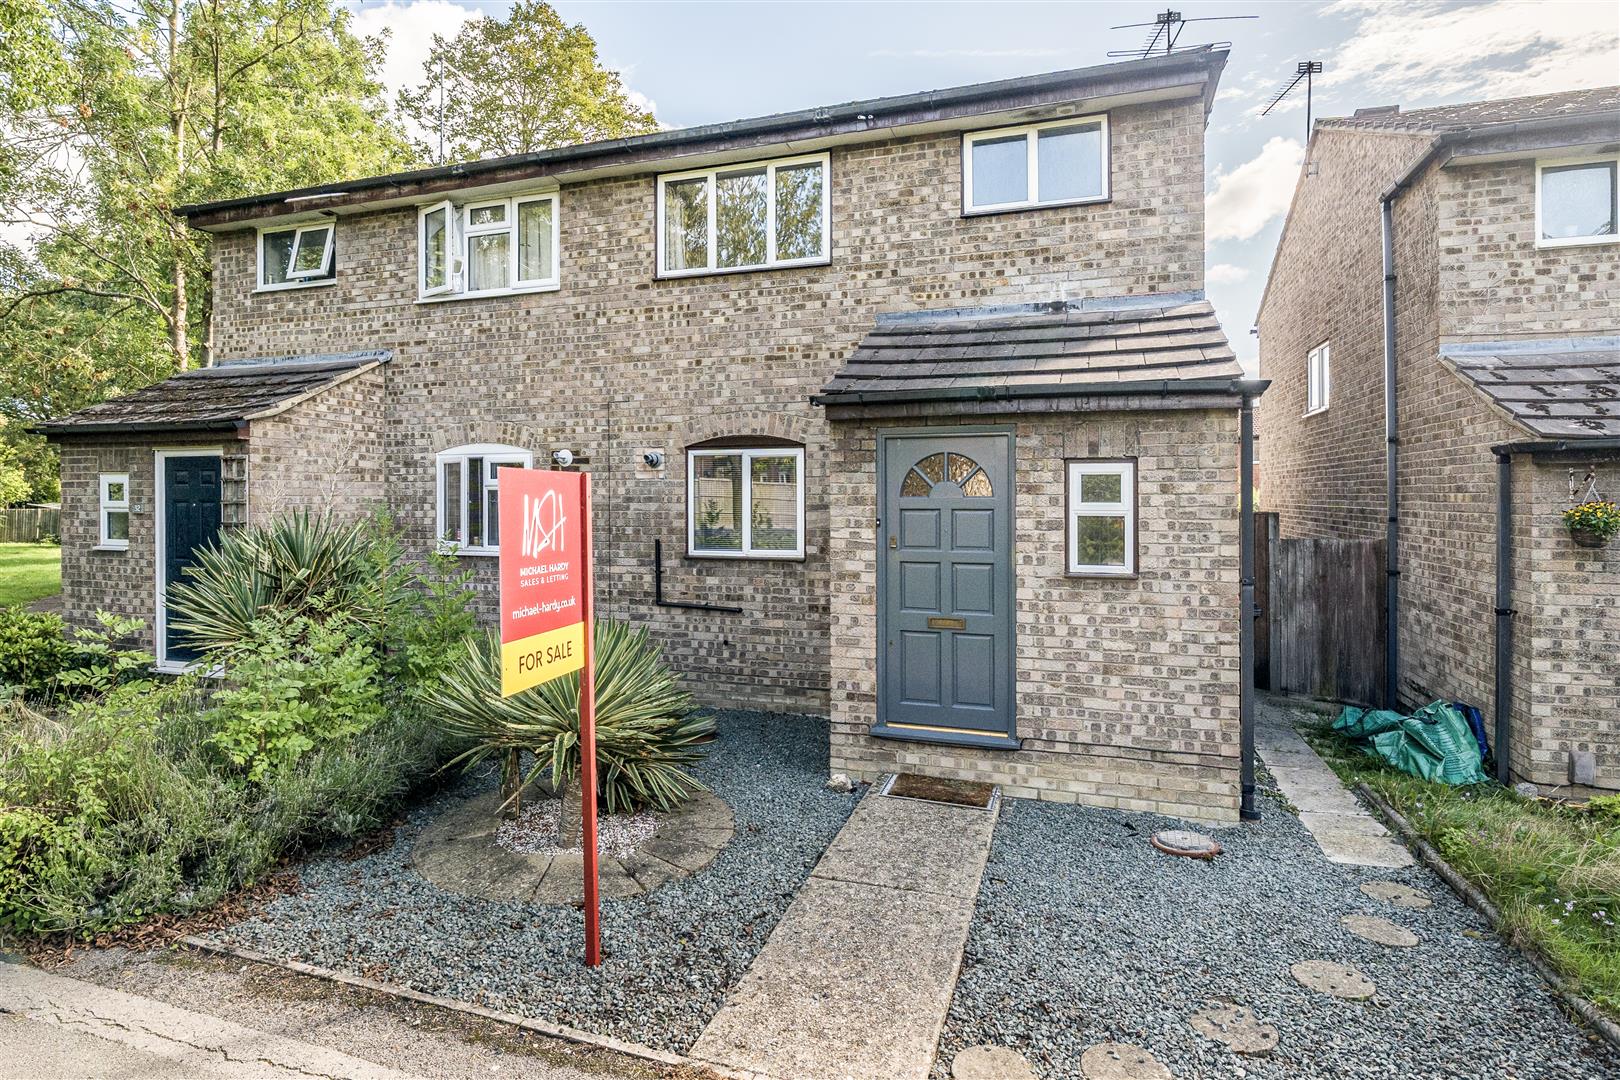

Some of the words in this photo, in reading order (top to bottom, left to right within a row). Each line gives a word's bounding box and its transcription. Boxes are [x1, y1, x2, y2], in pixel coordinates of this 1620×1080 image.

[520, 565, 547, 577] MICHAEL
[549, 562, 569, 572] HARDY
[520, 577, 539, 588] SALES
[541, 576, 545, 584] &
[547, 573, 569, 584] LETTING
[512, 596, 577, 620] michael-hardy.co.uk
[519, 650, 543, 674] FOR
[546, 641, 573, 664] SALE
